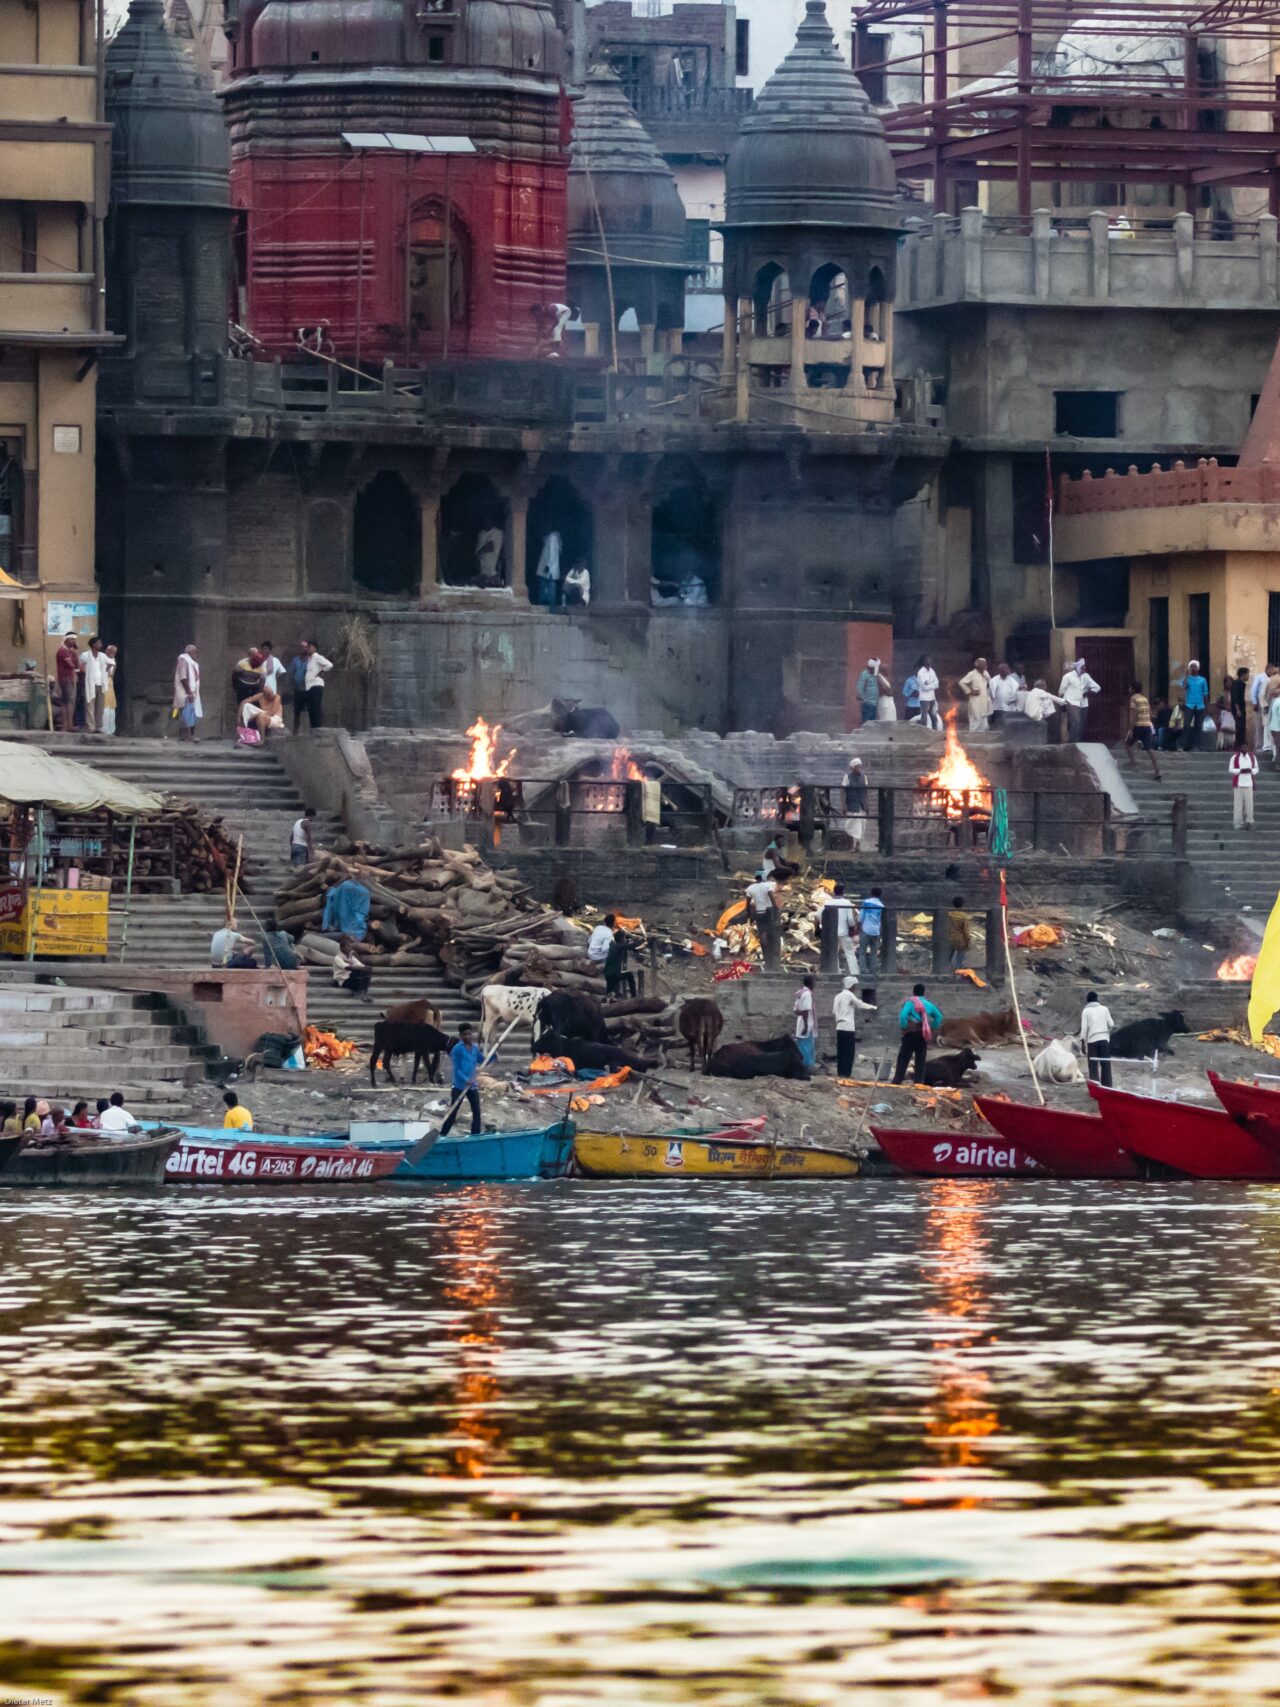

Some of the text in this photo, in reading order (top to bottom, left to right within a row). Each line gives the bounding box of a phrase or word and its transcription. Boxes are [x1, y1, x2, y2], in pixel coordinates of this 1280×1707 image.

[165, 1146, 257, 1176] airtel 4G
[261, 1158, 295, 1175] A-243
[314, 1156, 374, 1178] airtel 4G
[956, 1142, 1017, 1168] airtel
